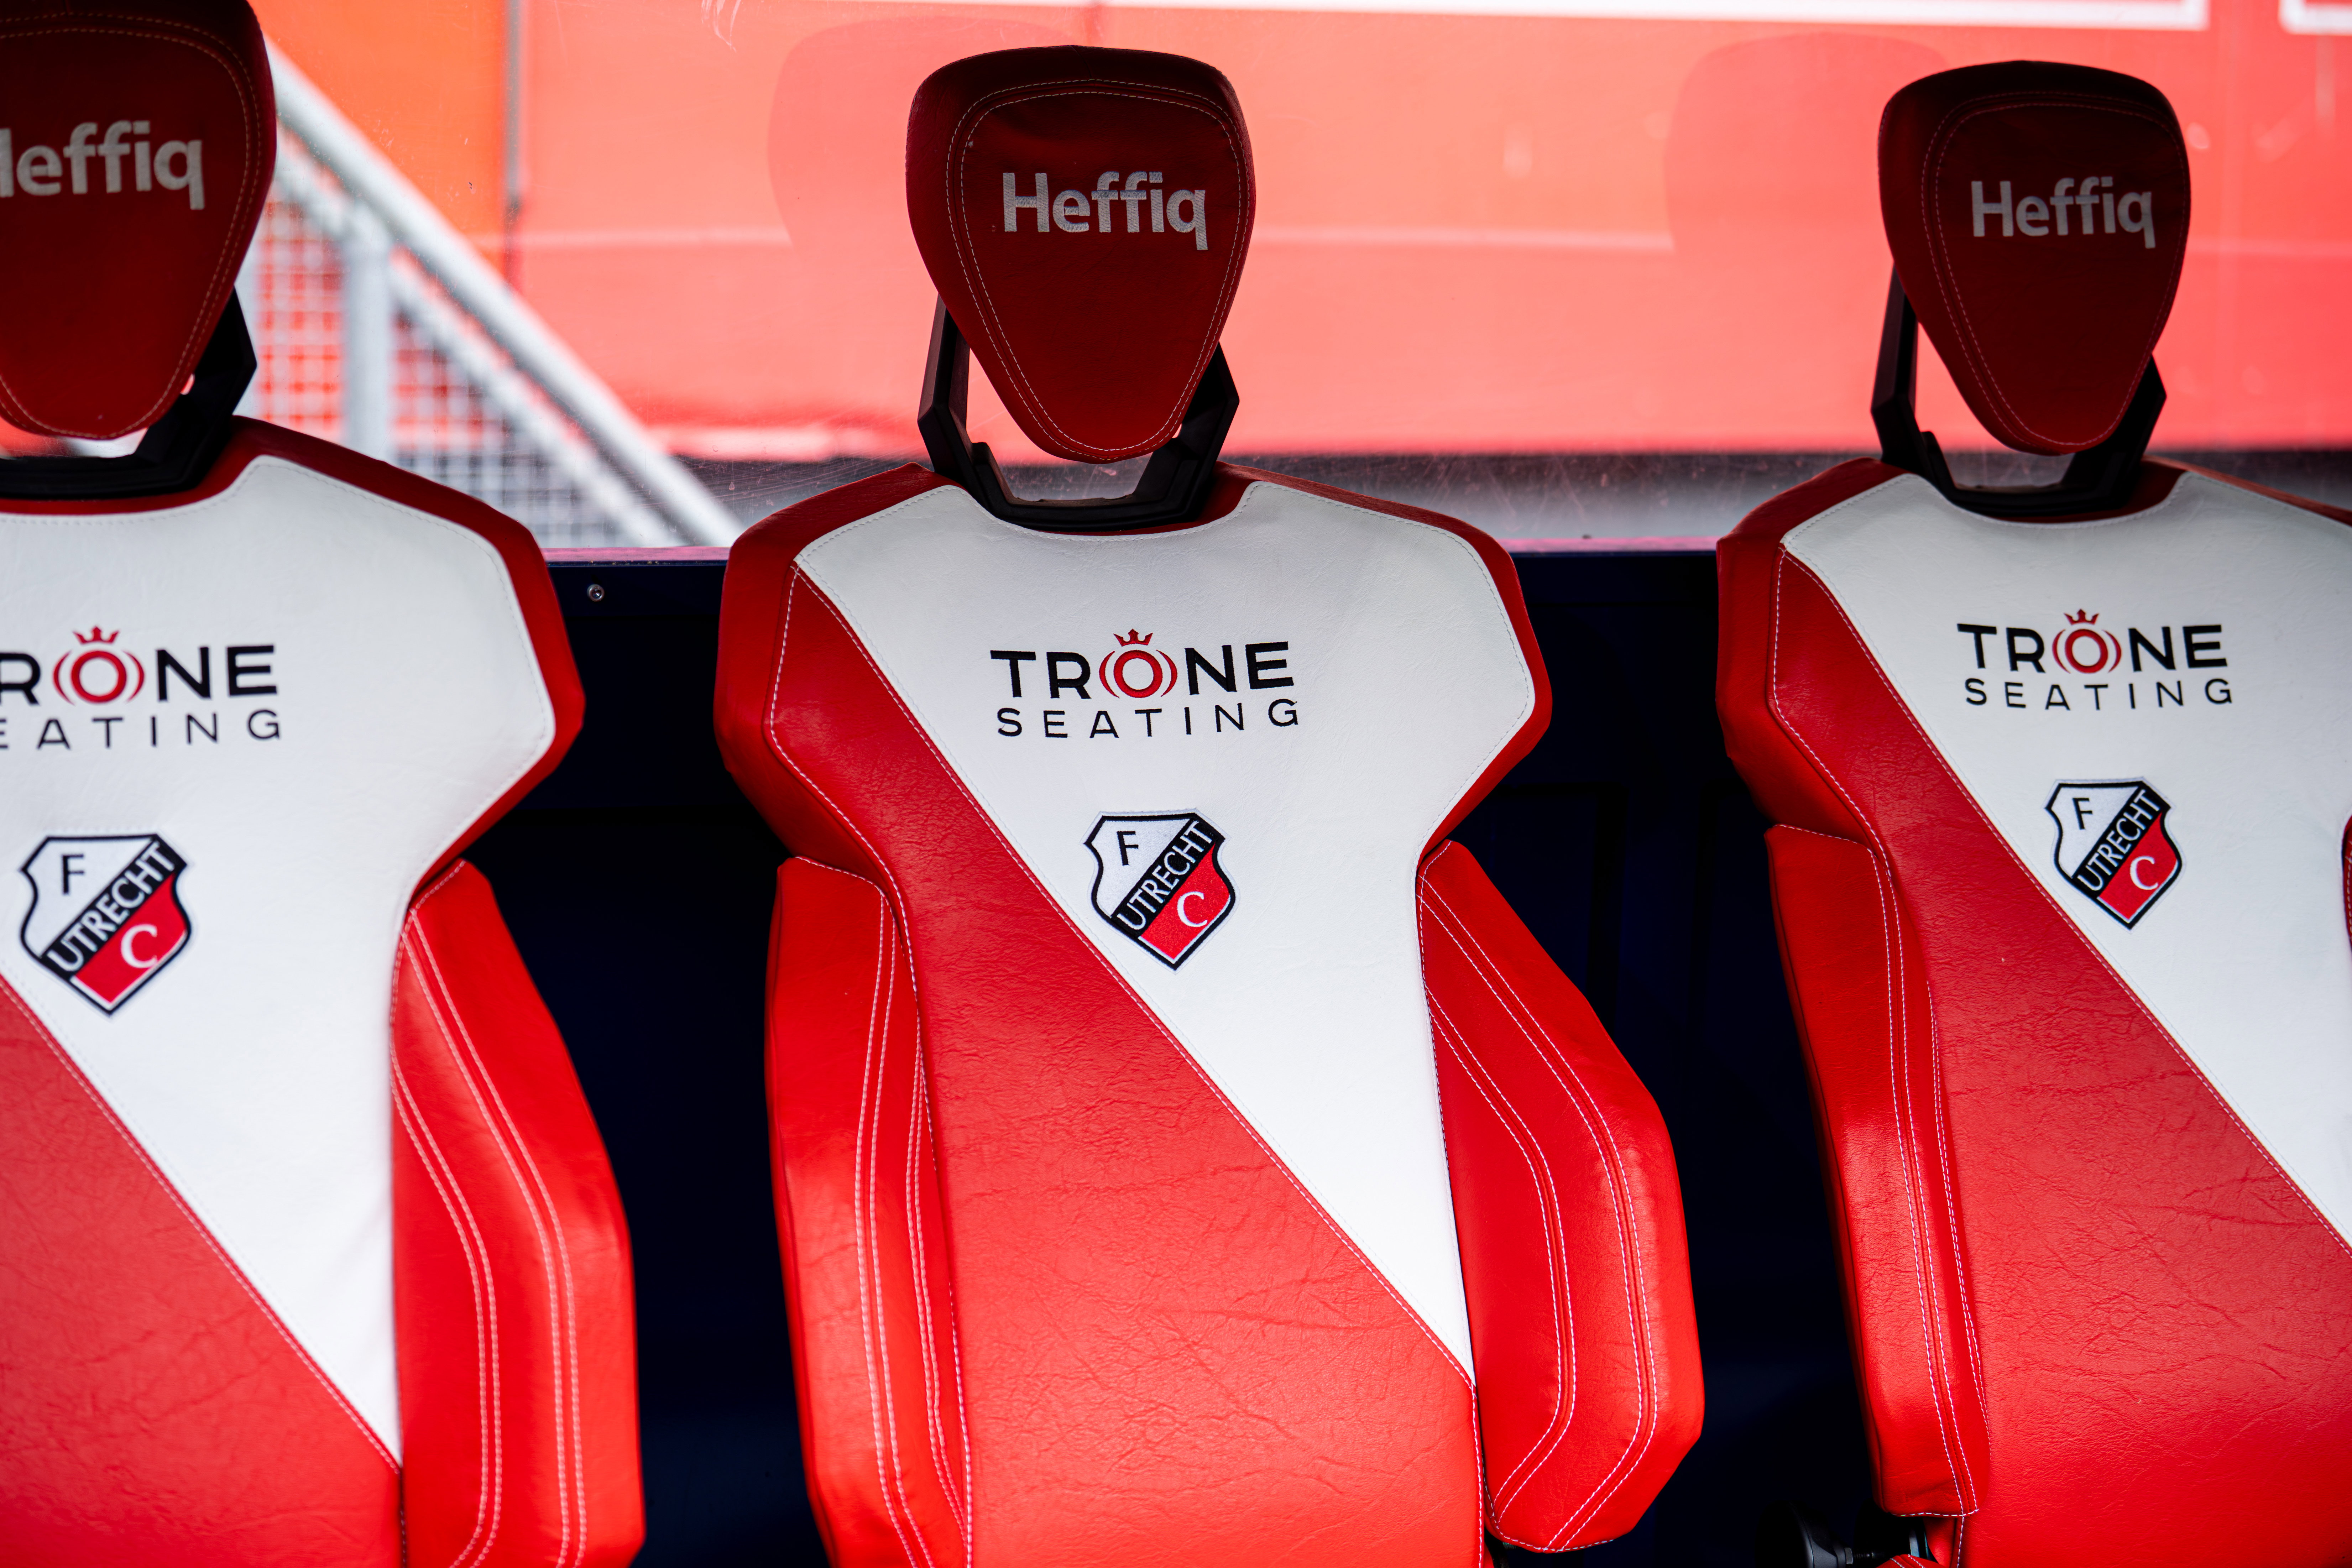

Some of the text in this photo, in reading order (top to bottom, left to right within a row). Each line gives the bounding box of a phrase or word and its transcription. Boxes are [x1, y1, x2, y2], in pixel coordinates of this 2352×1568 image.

[0, 121, 204, 209] effiq
[1003, 172, 1208, 250] Heffiq
[1972, 177, 2155, 247] Heffiq
[1965, 678, 2232, 711] SEATING
[997, 699, 1298, 738] SEATING
[2073, 798, 2092, 830] F
[1117, 831, 1139, 866] F
[2077, 789, 2160, 891] UTRECHT
[63, 855, 83, 894] F
[1117, 820, 1212, 931] UTRECHT
[2130, 857, 2158, 890] C
[47, 841, 175, 972] UTRECHT
[1177, 892, 1207, 927] C
[120, 924, 158, 969] C
